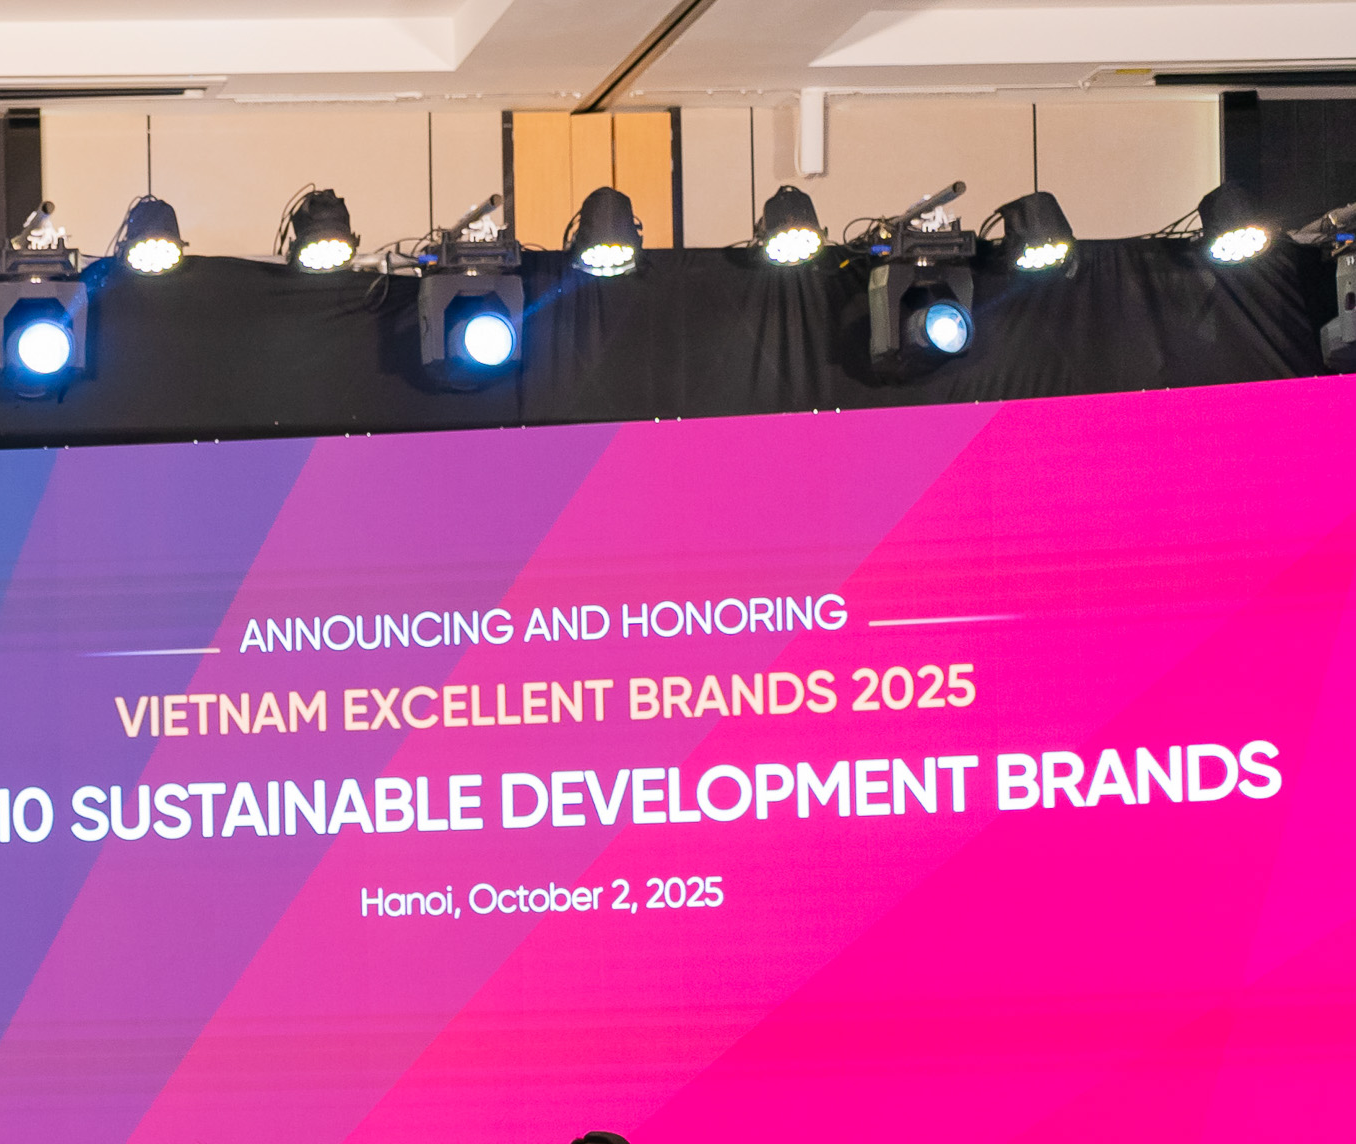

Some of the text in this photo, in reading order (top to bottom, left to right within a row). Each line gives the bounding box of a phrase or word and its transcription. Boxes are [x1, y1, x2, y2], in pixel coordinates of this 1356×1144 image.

[239, 593, 848, 654] ANNOUNCING AND HONORING
[114, 663, 976, 738] VIETNAM EXCELLENT BRANDS 2025
[70, 774, 484, 842] SUSTAINABLE
[501, 755, 979, 829] DEVELOPMENT
[996, 740, 1282, 811] BRANDS
[361, 876, 724, 919] Hanoi, October 2, 2025
